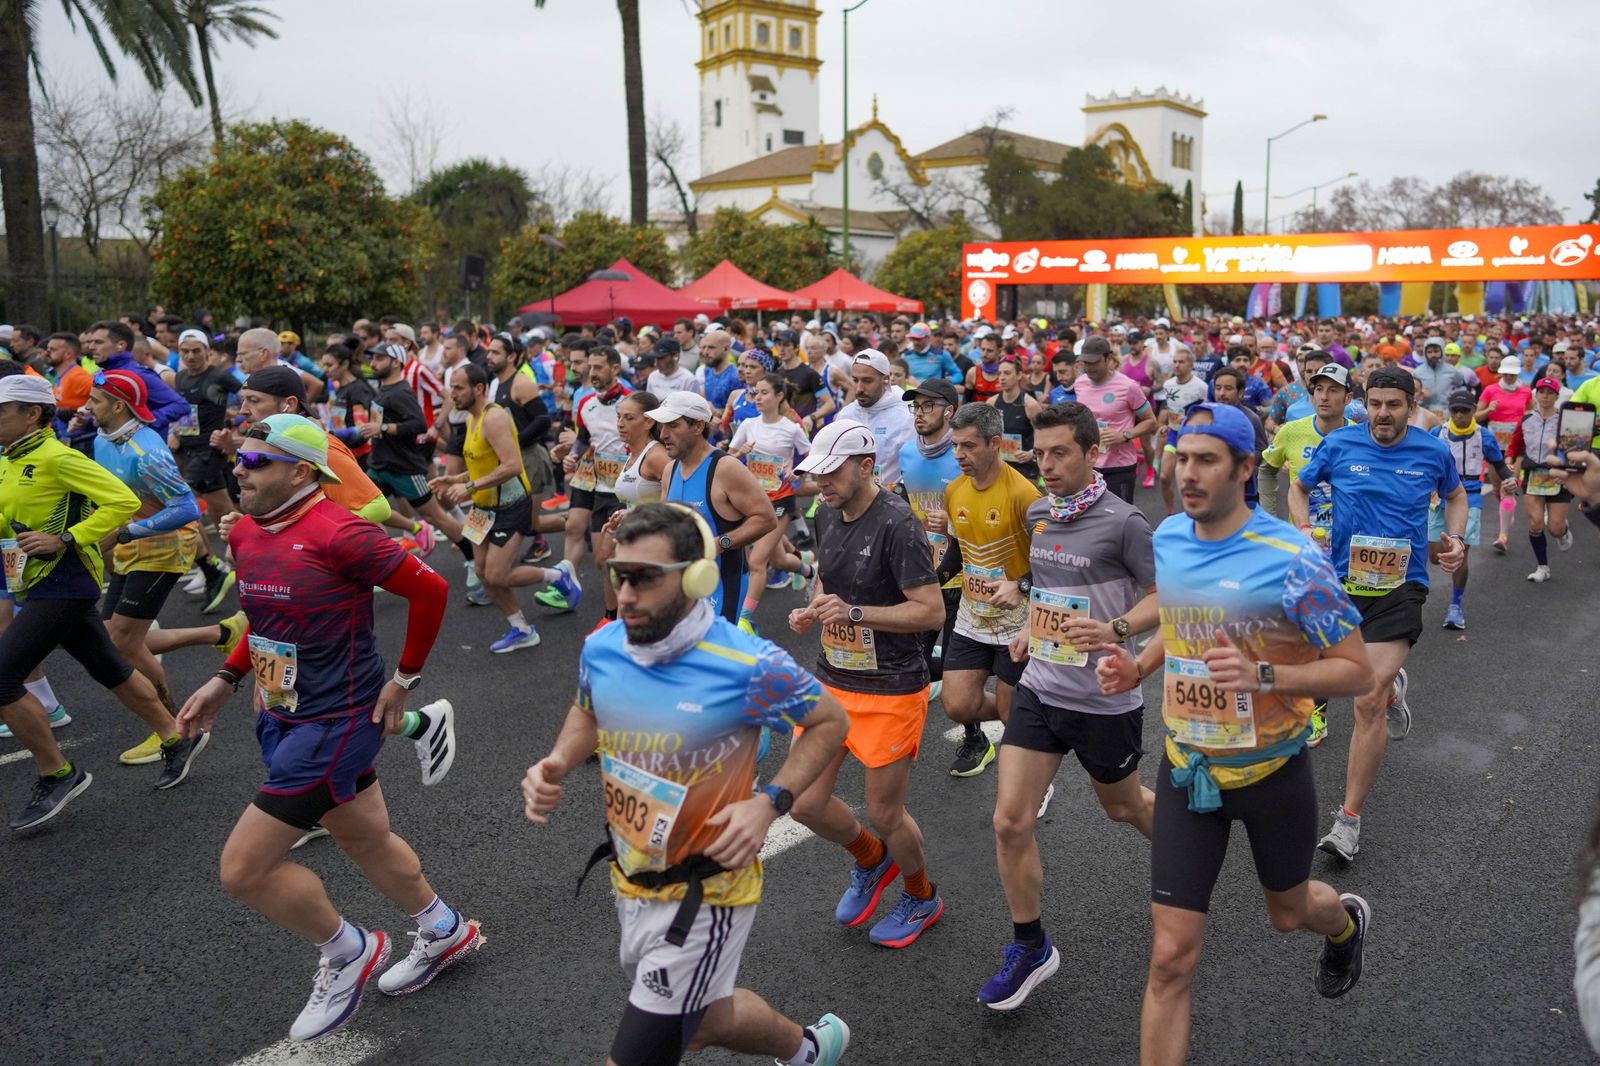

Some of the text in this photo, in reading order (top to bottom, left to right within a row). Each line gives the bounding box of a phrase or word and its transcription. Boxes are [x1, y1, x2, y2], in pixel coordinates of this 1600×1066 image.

[598, 461, 619, 474] 6412
[751, 464, 774, 475] 5356
[1359, 549, 1396, 567] 6072
[279, 586, 291, 594] PIE
[1036, 607, 1070, 633] 7755
[1160, 606, 1225, 625] MEDIO
[1176, 680, 1227, 710] 5498
[601, 730, 682, 752] MEDIO
[604, 781, 649, 832] 5903
[641, 974, 673, 999] adidas
